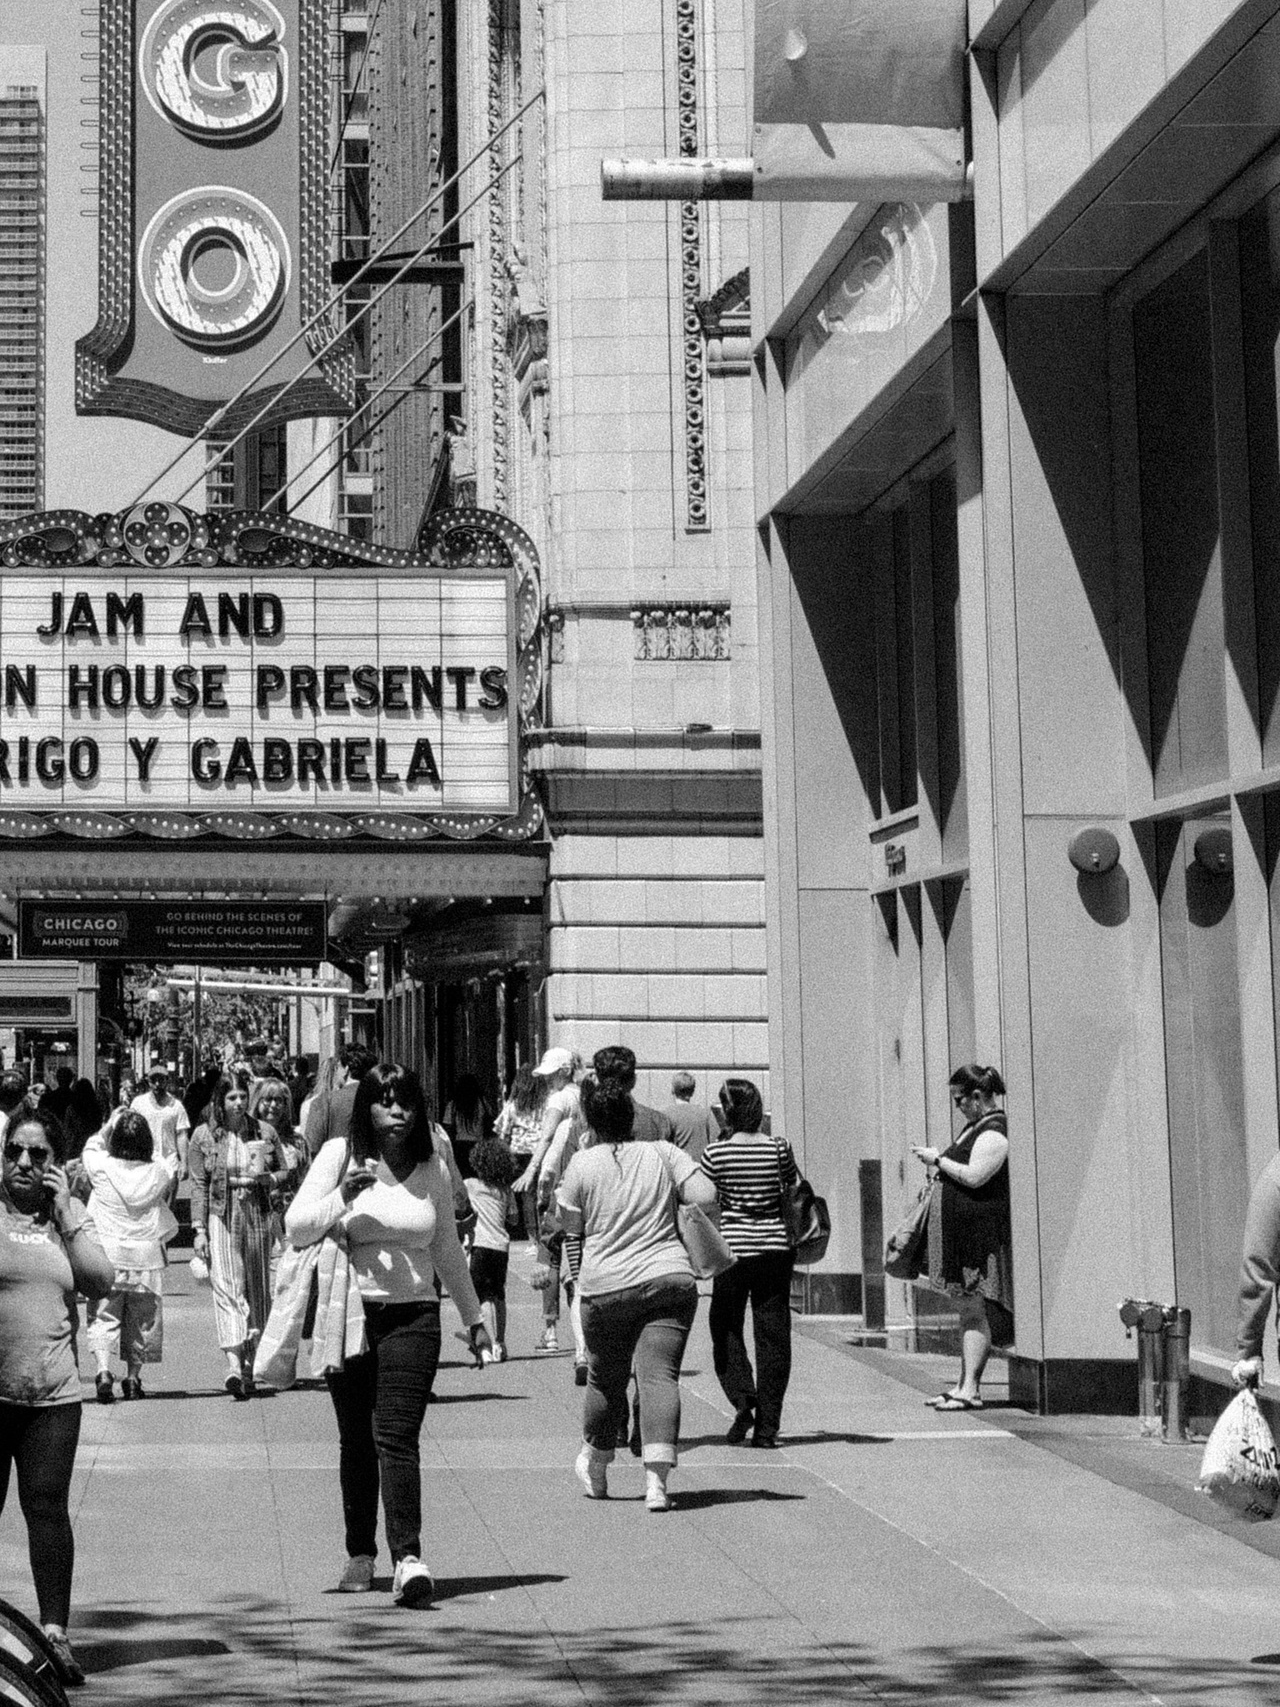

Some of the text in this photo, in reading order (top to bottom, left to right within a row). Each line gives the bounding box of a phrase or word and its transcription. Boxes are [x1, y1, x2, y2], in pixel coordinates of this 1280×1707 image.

[36, 592, 285, 638] JAM AND
[68, 664, 228, 711] HOUSE
[256, 665, 509, 712] PRESENTS
[129, 737, 159, 782] Y
[190, 737, 442, 785] GABRIELA
[167, 912, 302, 922] GO BEHIND THE SCENES OF
[43, 918, 118, 930] CHICAGO
[155, 925, 175, 934] THE
[177, 925, 214, 935] ICONIC
[216, 926, 264, 935] CHICAGO
[42, 938, 120, 948] MARQUEE TOUR
